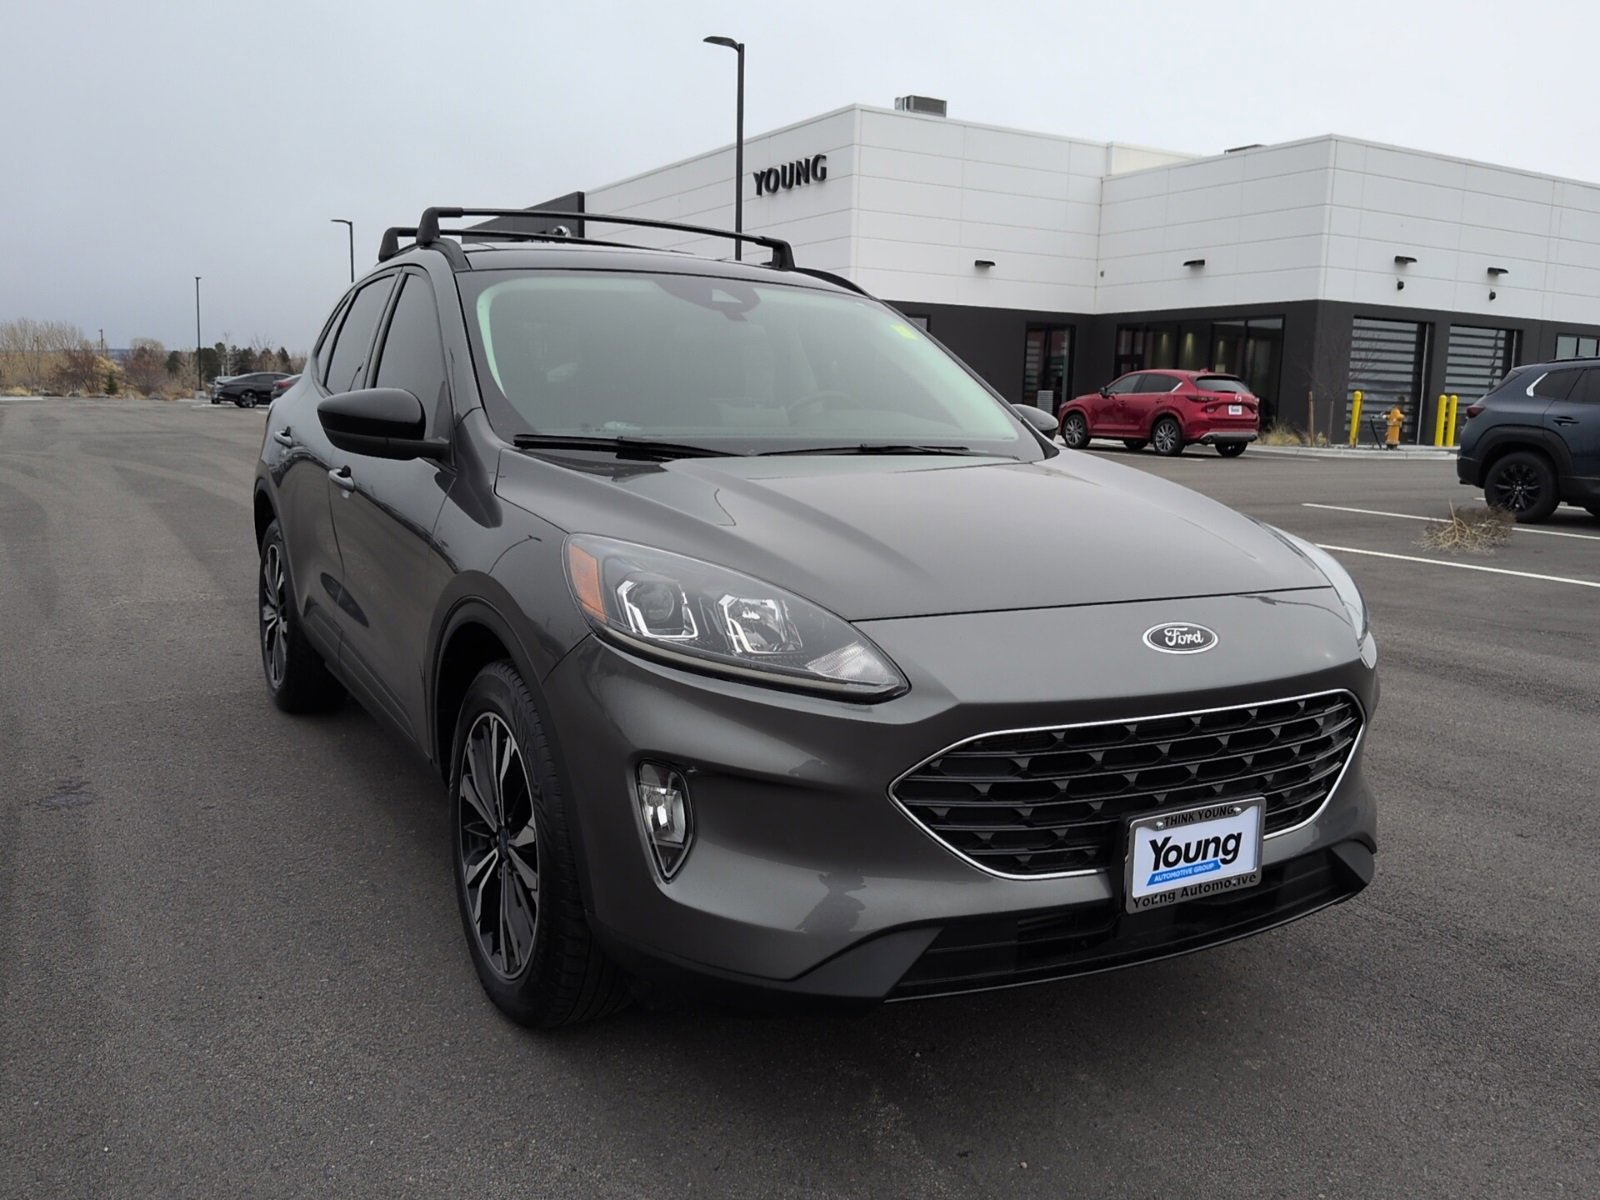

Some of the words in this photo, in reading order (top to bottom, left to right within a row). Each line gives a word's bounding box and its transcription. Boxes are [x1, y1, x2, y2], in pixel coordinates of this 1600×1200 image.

[753, 154, 827, 196] YOUNG
[1164, 627, 1204, 646] Ford
[1164, 812, 1194, 827] THINK
[1198, 805, 1234, 820] YOUNG
[1149, 832, 1243, 871] Young
[1154, 867, 1193, 882] AUTOMOTIVE
[1194, 863, 1214, 873] GROUP
